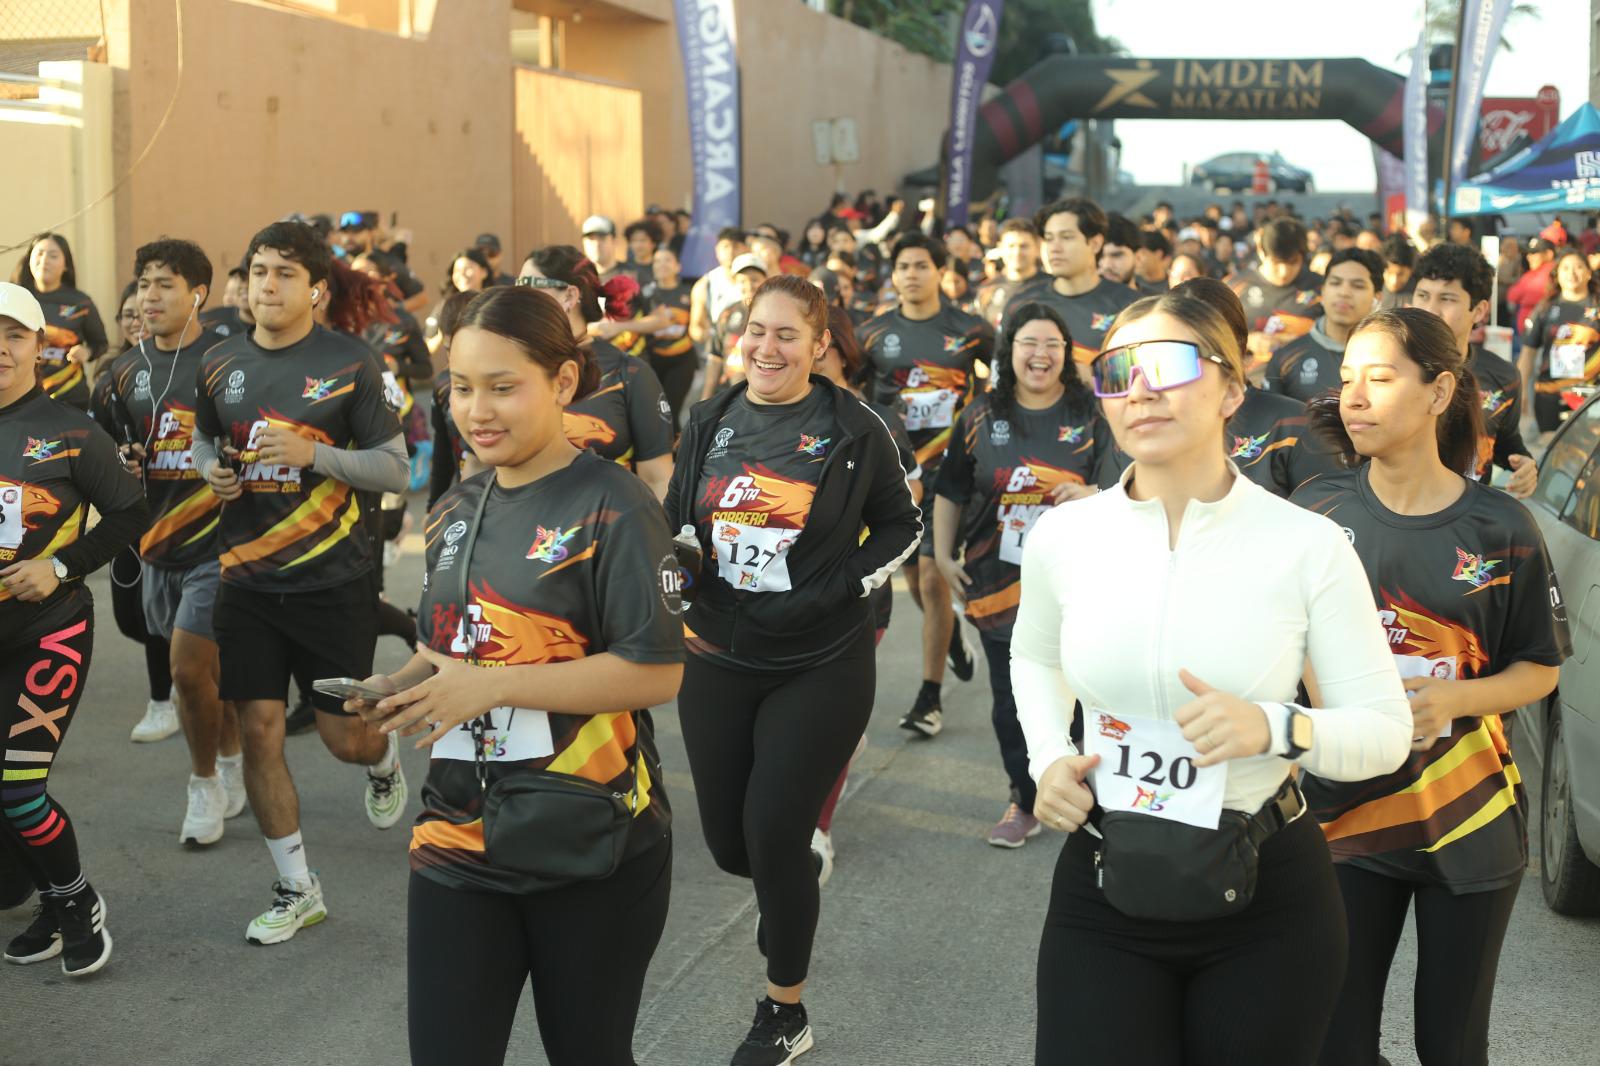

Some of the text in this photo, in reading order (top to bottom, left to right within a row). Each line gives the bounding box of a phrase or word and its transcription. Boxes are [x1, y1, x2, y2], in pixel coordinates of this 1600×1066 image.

[1173, 60, 1324, 88] IMDEM
[717, 475, 762, 509] 6TA
[728, 542, 777, 573] 127
[1112, 744, 1198, 790] 120
